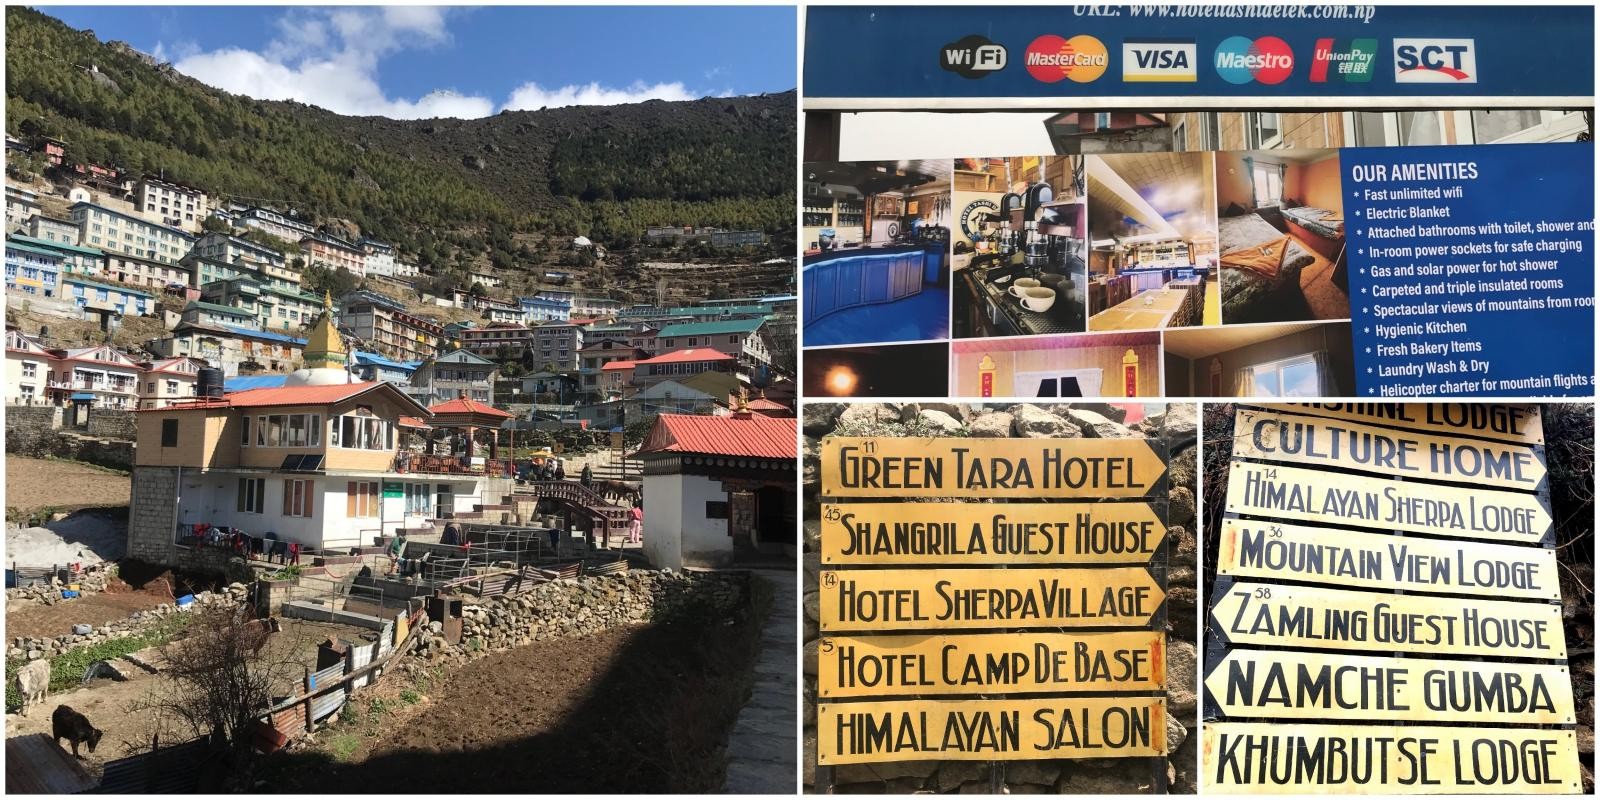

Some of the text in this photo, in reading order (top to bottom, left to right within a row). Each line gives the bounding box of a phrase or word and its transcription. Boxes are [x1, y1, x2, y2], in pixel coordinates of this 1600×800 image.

[1026, 51, 1106, 66] MasterCard
[1132, 50, 1188, 68] VISA
[1216, 52, 1292, 69] Maestro
[1316, 49, 1374, 64] UnionPay
[1397, 46, 1468, 70] SCT
[1338, 62, 1368, 74] 银联
[1352, 162, 1478, 182] OUR AMENITIES
[1365, 186, 1462, 200] Fast unlimited wifi
[1367, 206, 1450, 220] Electric Blanket
[1368, 226, 1416, 239] Attached
[1418, 224, 1476, 237] bathrooms
[1478, 223, 1502, 234] with
[1504, 221, 1534, 234] toilet,
[1536, 220, 1574, 232] shower
[1370, 239, 1582, 259] In-room power sockets for safe charging
[1371, 259, 1558, 277] Gas and solar power for hot shower
[1372, 278, 1563, 299] Carpeted and triple insulated rooms
[1374, 303, 1438, 319] Spectacular
[1441, 302, 1473, 313] views
[1476, 300, 1486, 312] of
[1488, 297, 1544, 311] mountains
[1547, 296, 1571, 308] from
[1376, 321, 1467, 339] Hygienic Kitchen
[1378, 340, 1481, 356] Fresh Bakery Items
[1378, 360, 1490, 377] Laundry Wash & Dry
[1380, 383, 1437, 397] Helicopter
[1439, 381, 1479, 394] charter
[1482, 379, 1497, 391] for
[1500, 375, 1551, 390] mountain
[1553, 374, 1588, 389] flights
[1427, 402, 1526, 436] LODGE
[863, 442, 874, 453] 11
[1252, 418, 1535, 483] CULTURE HOME
[840, 446, 1144, 489] GREEN TARA HOTEL
[1264, 469, 1277, 479] 14
[1244, 470, 1539, 535] HIMALAYAN SHERPA LODGE
[825, 509, 840, 521] 45
[841, 513, 1154, 555] SHANGRILA GUEST HOUSE
[1268, 526, 1283, 538] 36
[1240, 529, 1541, 590] MOUNTAIN VIEW LODGE
[824, 574, 836, 586] 14
[838, 579, 1151, 622] HOTEL SHERPA VILLAGE
[1255, 587, 1272, 599] 58
[1232, 592, 1550, 649] ZAMLING GUEST HOUSE
[822, 640, 833, 652] 5
[838, 642, 1149, 687] HOTEL CAMP DE BASE
[1225, 660, 1556, 713] NAMCHE GUMBA
[836, 706, 1150, 755] HIMALAYAN SALON
[1215, 734, 1562, 785] KHUMBUTSE LODGE
